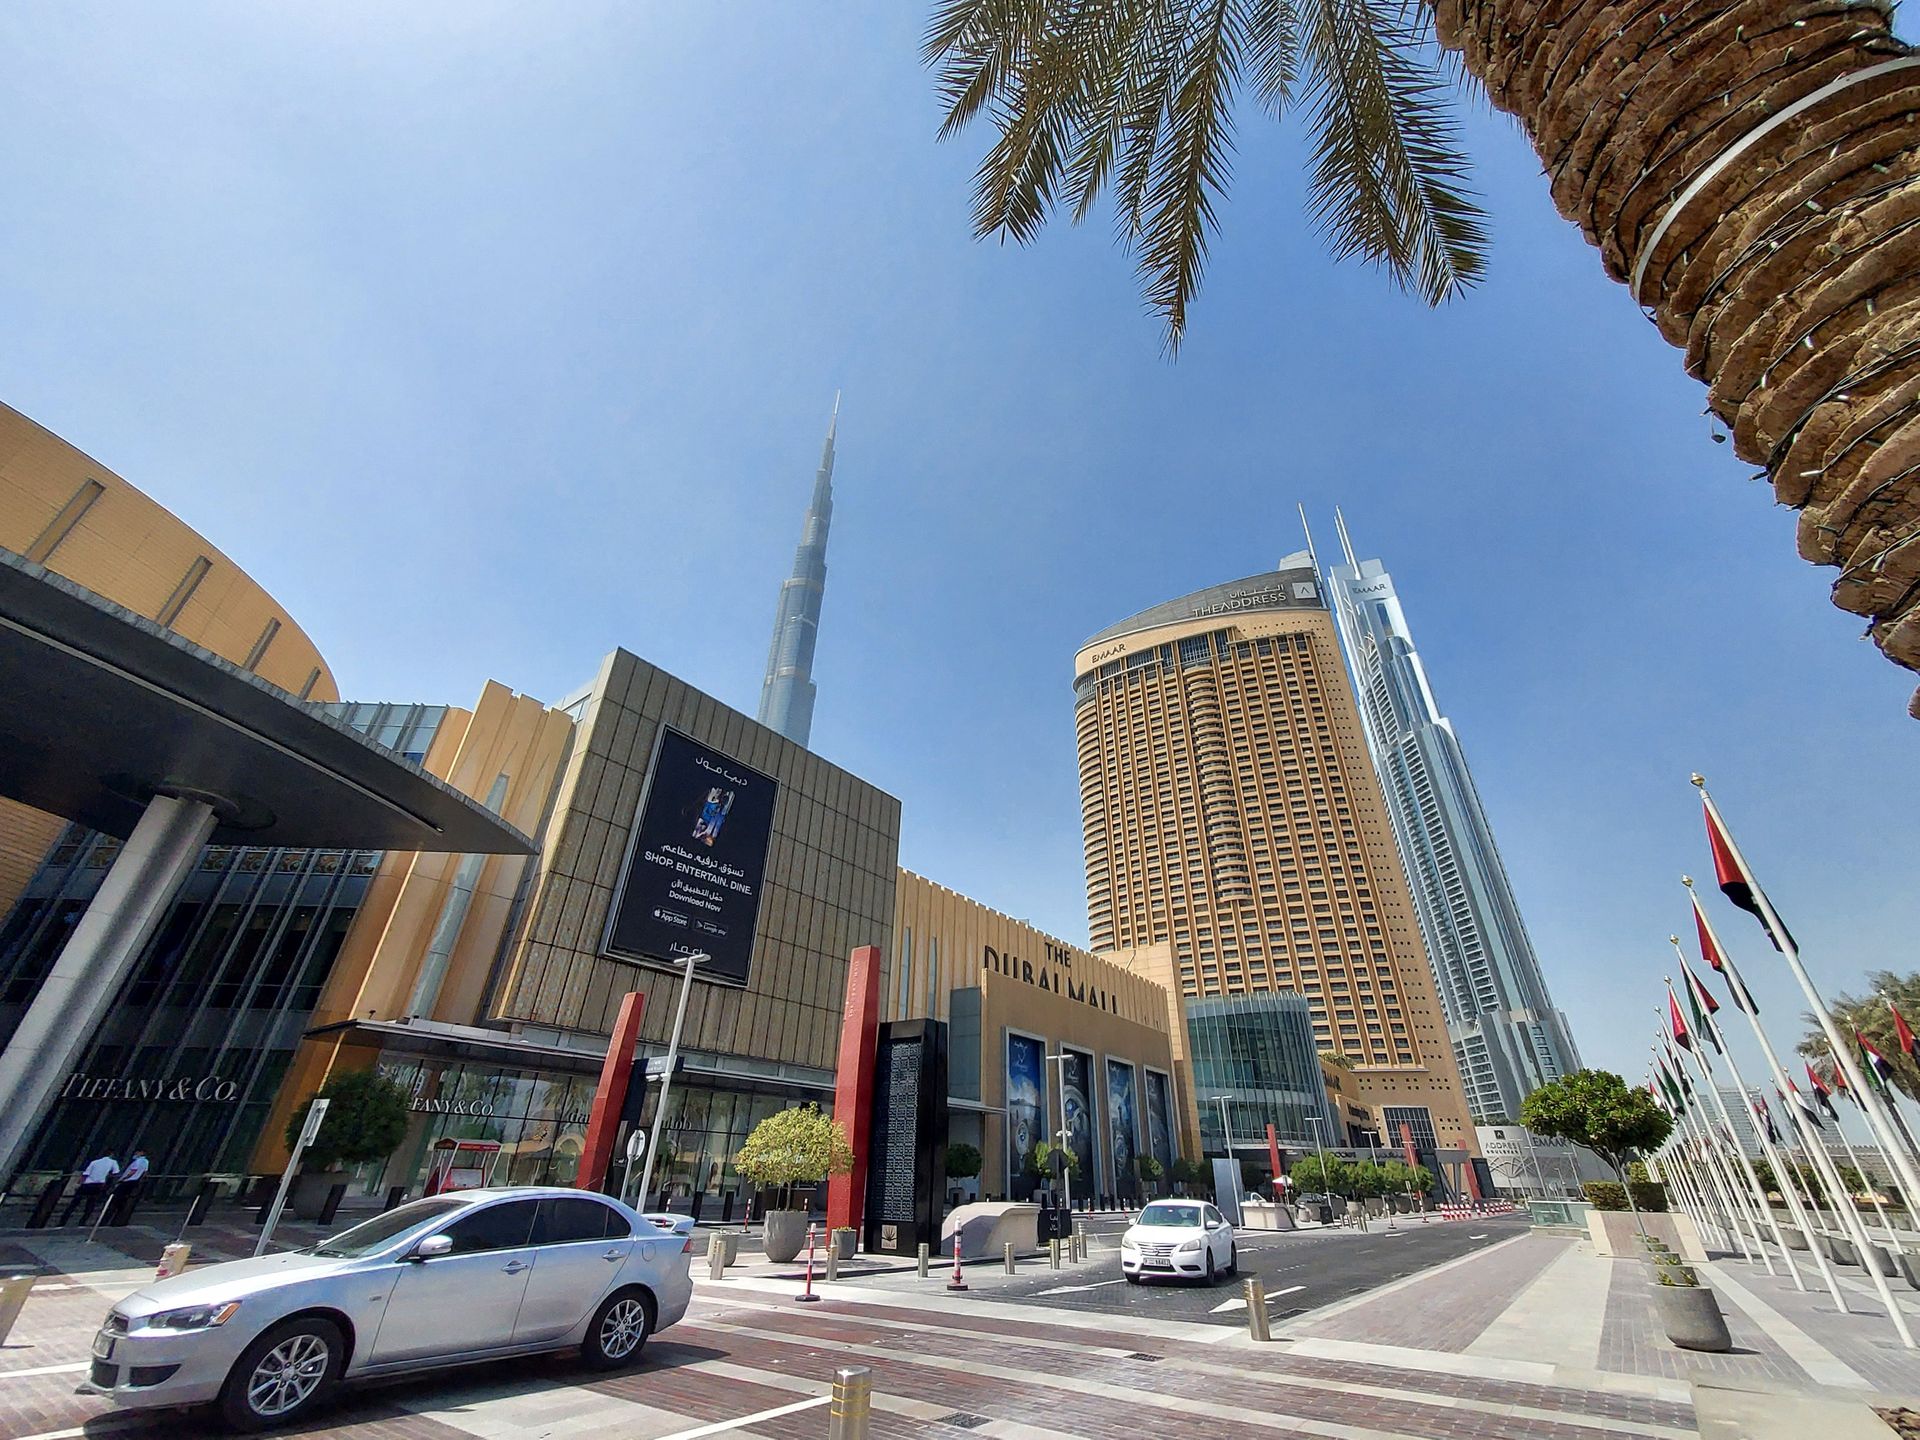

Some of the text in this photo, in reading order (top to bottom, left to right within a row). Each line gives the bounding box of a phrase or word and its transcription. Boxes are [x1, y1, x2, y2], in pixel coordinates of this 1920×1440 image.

[1352, 583, 1386, 593] EMAAR
[1091, 643, 1126, 663] EMAAR
[644, 851, 753, 896] SHOP. ENTERTAIN. DINE.
[668, 890, 722, 913] Download Now
[661, 912, 673, 923] App
[1045, 942, 1071, 968] THE
